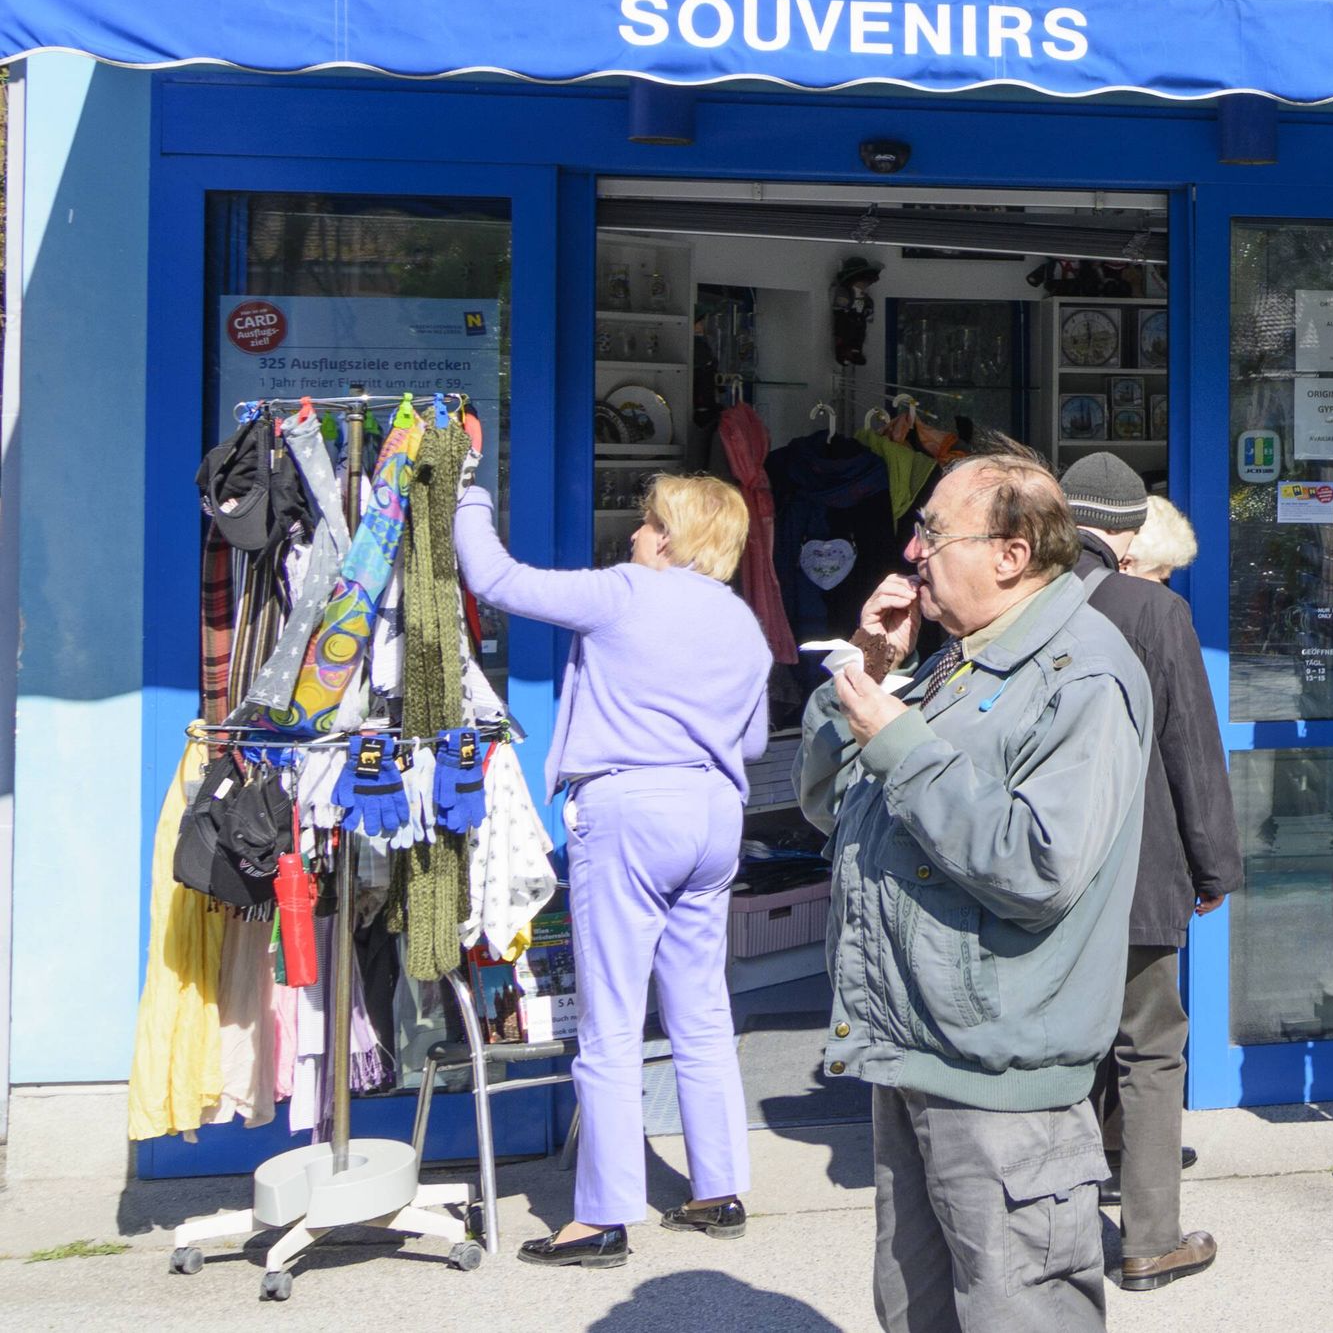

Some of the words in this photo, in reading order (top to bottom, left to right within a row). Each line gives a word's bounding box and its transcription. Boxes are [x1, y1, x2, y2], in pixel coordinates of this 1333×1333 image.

[234, 314, 278, 329] CARD
[259, 357, 286, 370] 325
[291, 357, 389, 373] Ausflugsziele
[394, 358, 471, 371] entdecken
[270, 377, 296, 389] Jahr
[300, 377, 334, 389] freier
[386, 380, 405, 388] um
